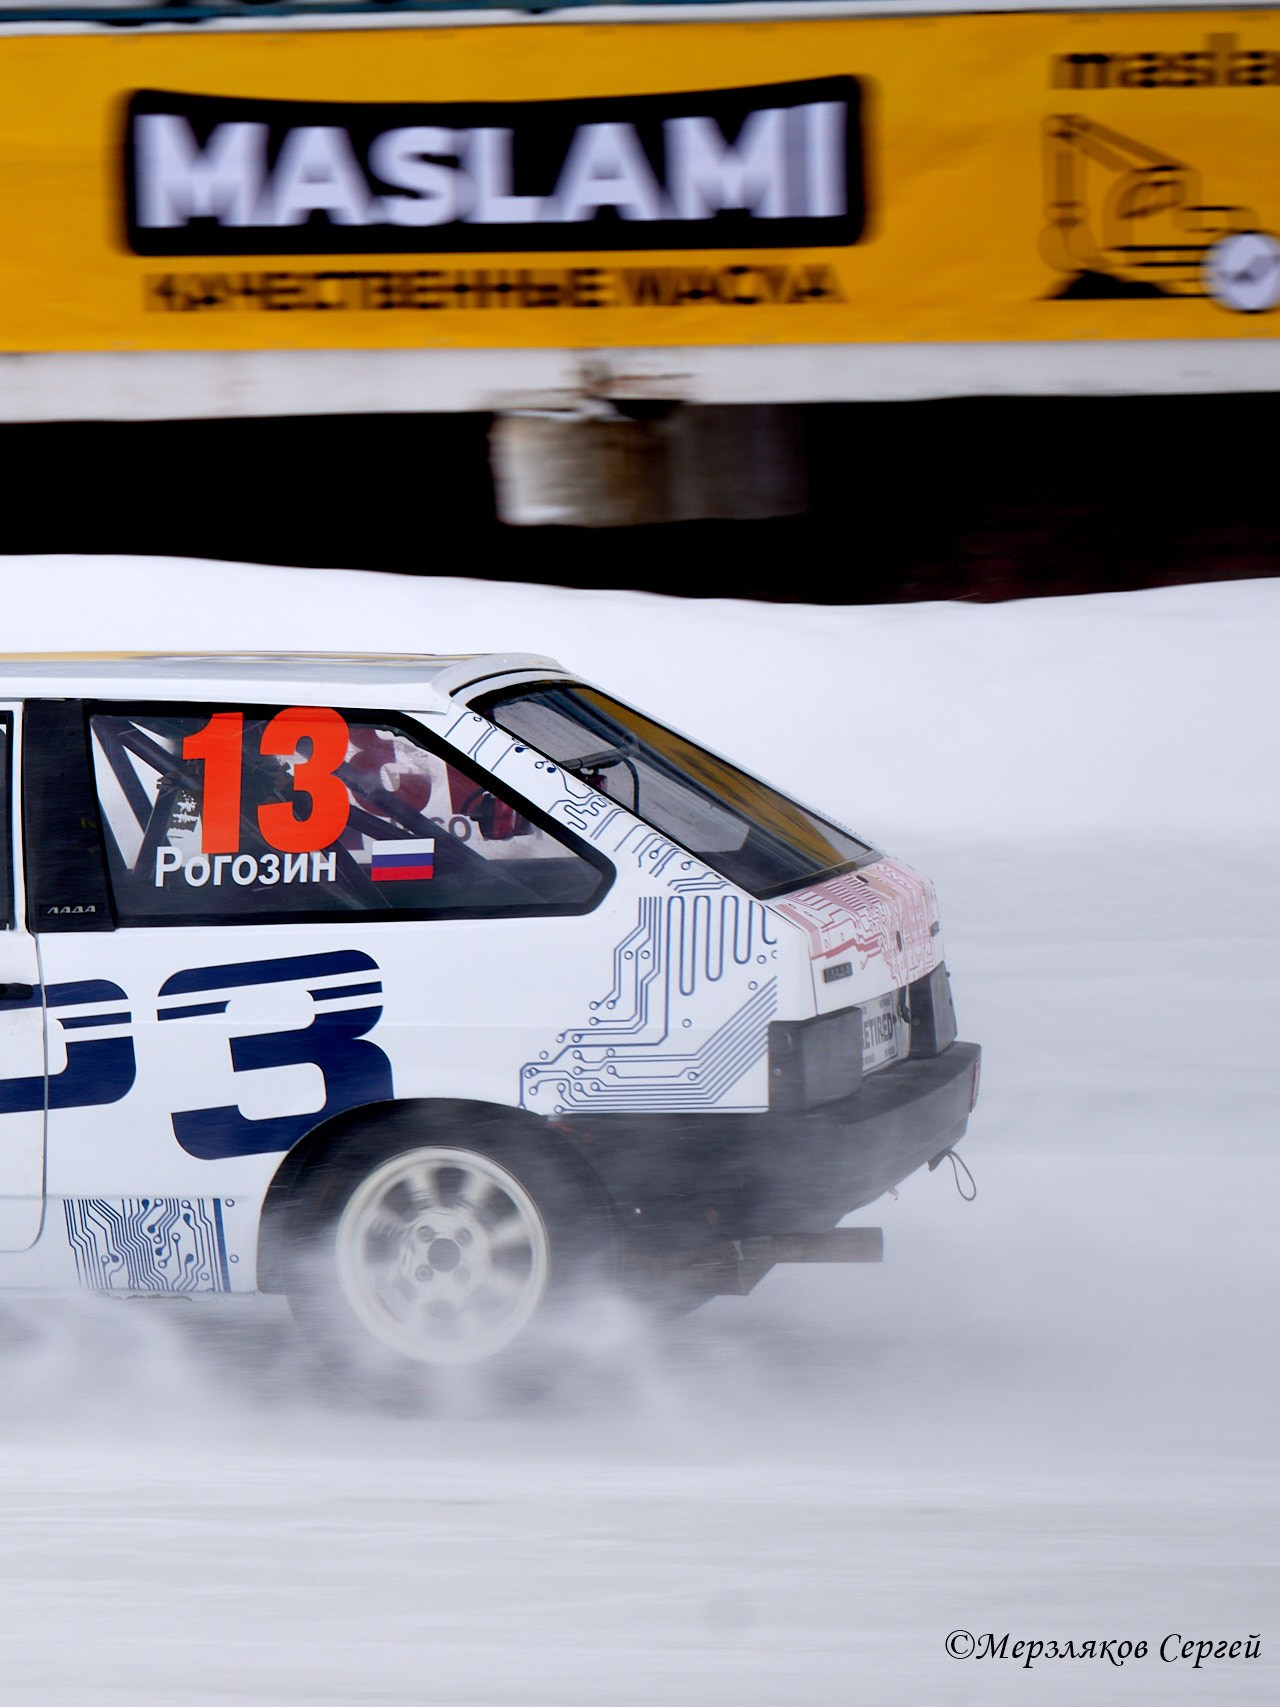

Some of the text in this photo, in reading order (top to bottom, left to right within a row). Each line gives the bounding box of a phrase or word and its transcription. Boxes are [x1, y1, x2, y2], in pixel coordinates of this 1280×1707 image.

[133, 100, 847, 228] MASLAMI
[182, 707, 350, 854] 13
[155, 845, 337, 888] Рогозин
